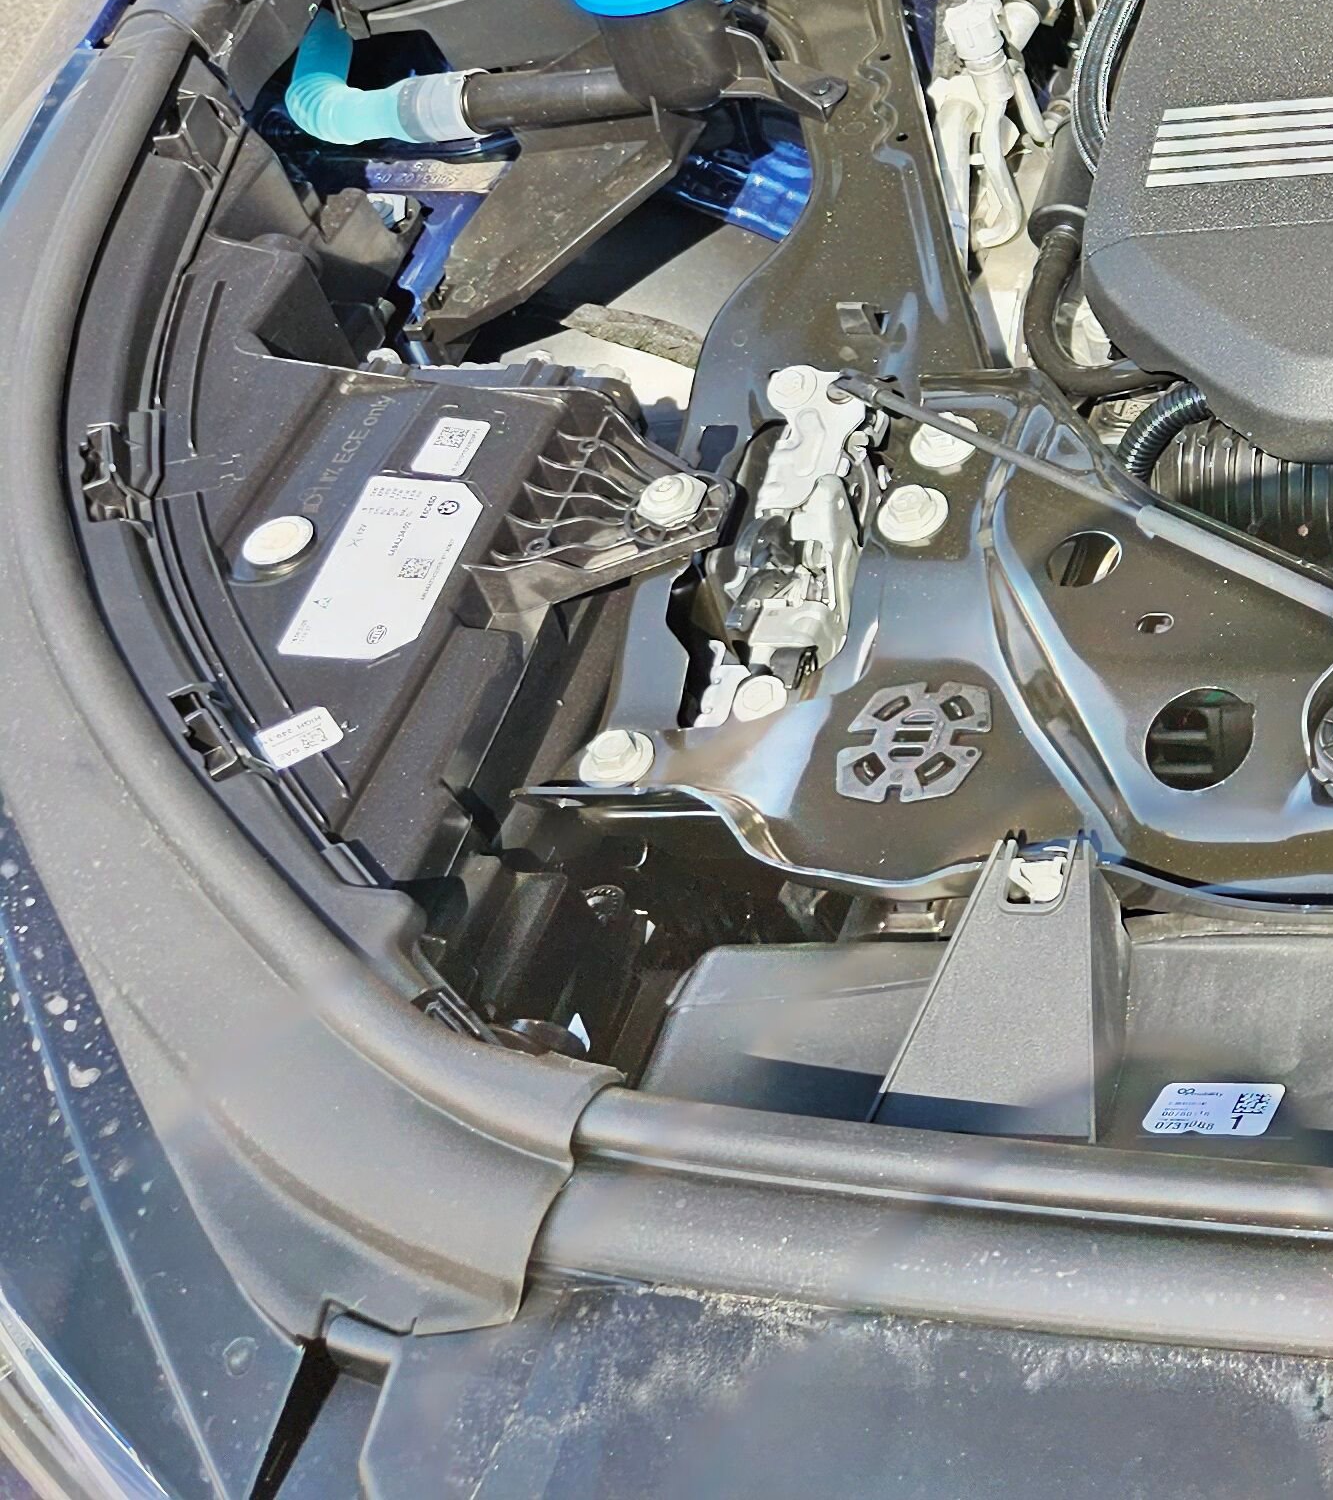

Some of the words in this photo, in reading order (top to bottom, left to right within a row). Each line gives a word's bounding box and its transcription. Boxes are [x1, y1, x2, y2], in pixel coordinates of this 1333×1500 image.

[332, 429, 369, 464] ECE
[362, 394, 396, 427] only
[1231, 1115, 1243, 1129] 1
